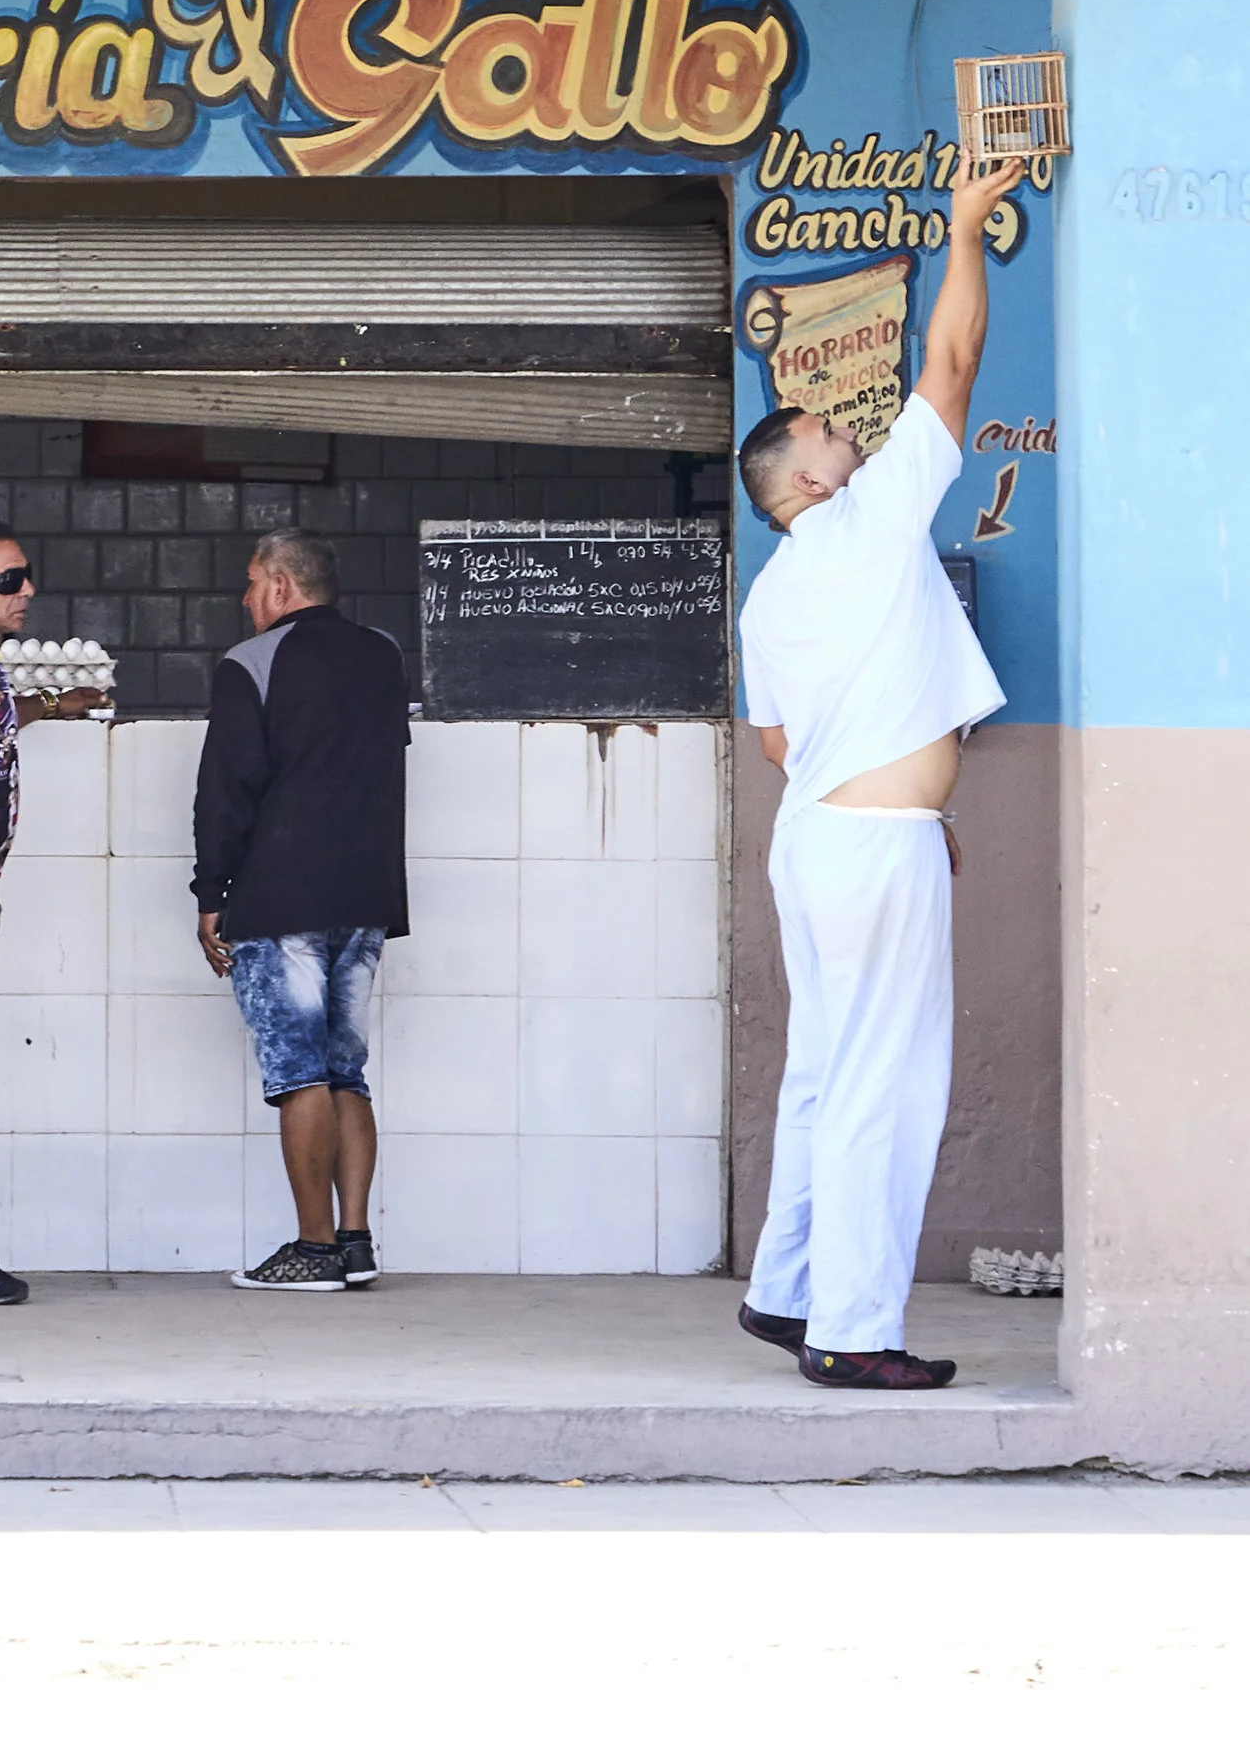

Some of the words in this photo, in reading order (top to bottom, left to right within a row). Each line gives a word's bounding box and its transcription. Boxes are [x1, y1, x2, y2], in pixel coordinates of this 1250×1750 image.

[759, 130, 934, 190] Unidad
[777, 314, 900, 378] HORARIO
[808, 368, 832, 385] de
[974, 416, 1057, 454] Cuid
[462, 567, 500, 582] RES
[459, 602, 513, 618] HUEVO
